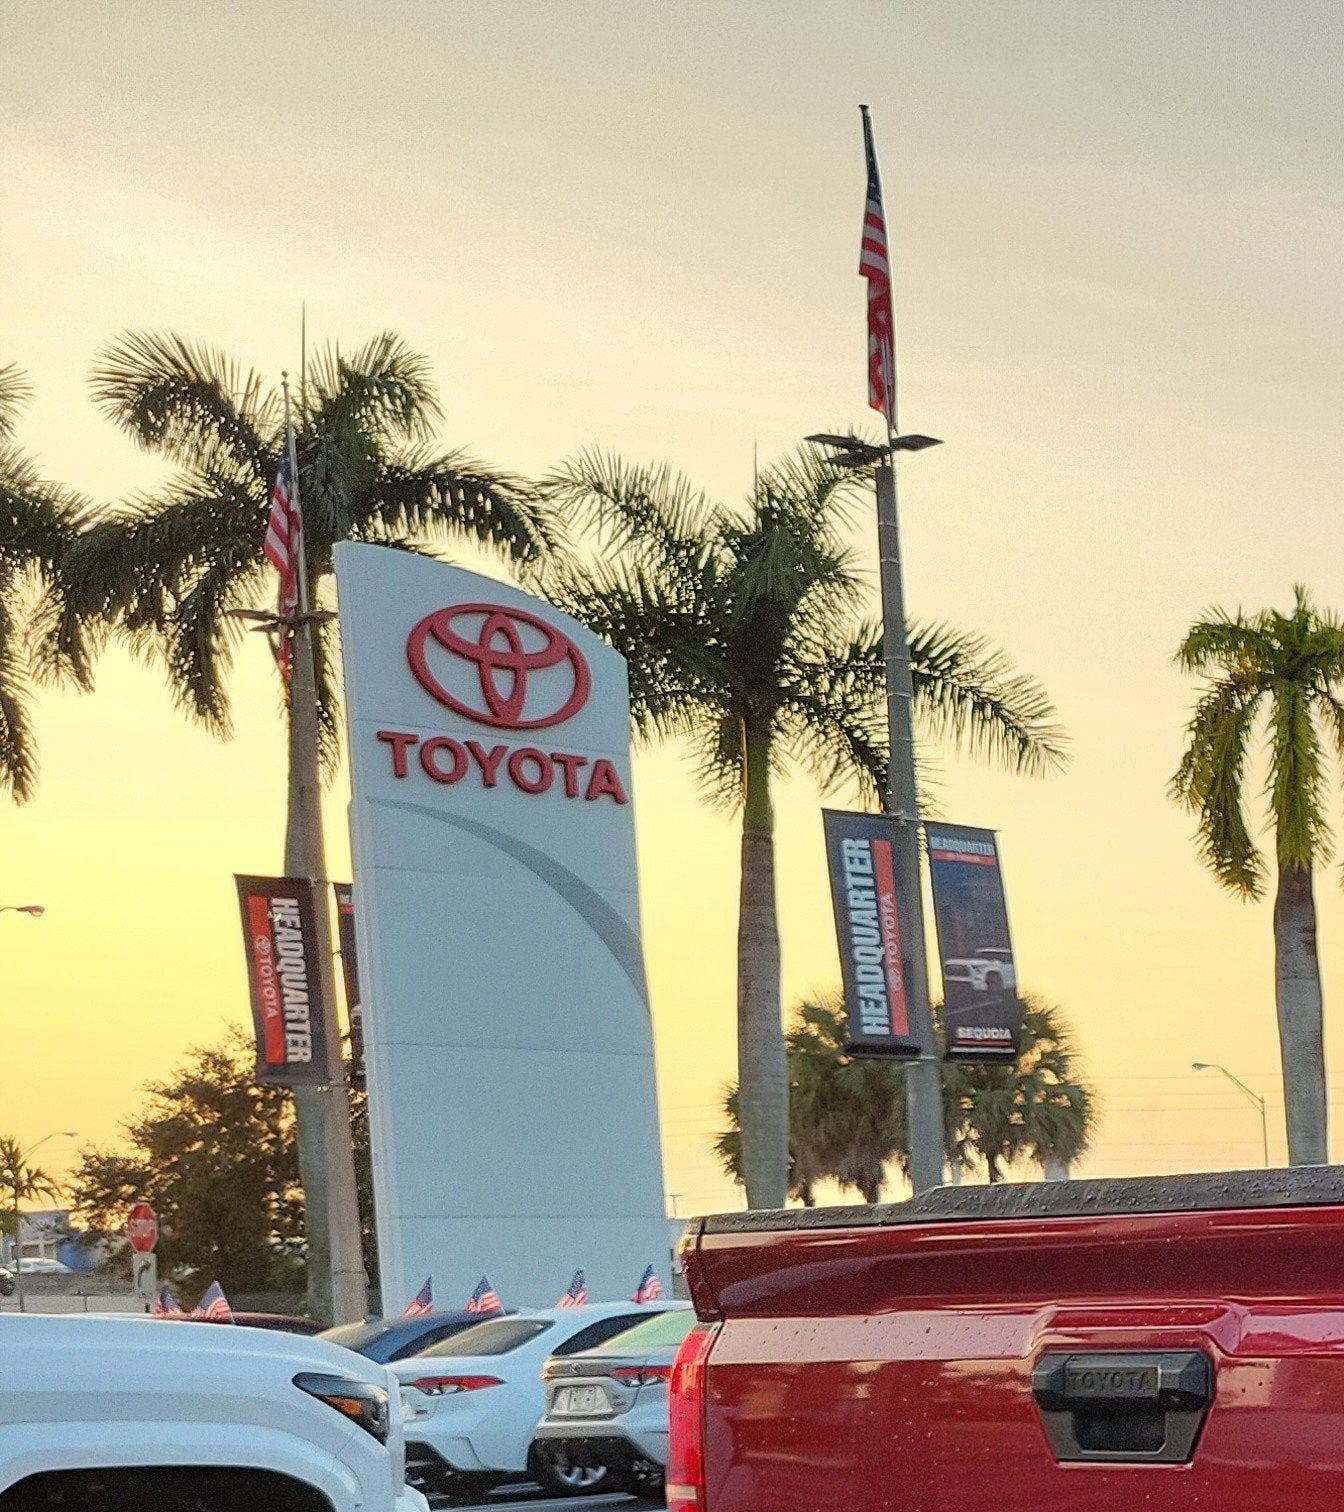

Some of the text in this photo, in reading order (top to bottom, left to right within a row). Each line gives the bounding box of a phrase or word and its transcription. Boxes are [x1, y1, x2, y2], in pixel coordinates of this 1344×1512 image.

[377, 730, 627, 804] TOYOTA
[841, 837, 890, 1035] HEADQUARTER
[879, 893, 901, 965] TOYOTA
[259, 957, 280, 1019] TOYOTA
[270, 897, 312, 1063] HEADQUARTER
[957, 1026, 1012, 1040] SEQUOIA
[1069, 1370, 1152, 1391] TOYOTA
